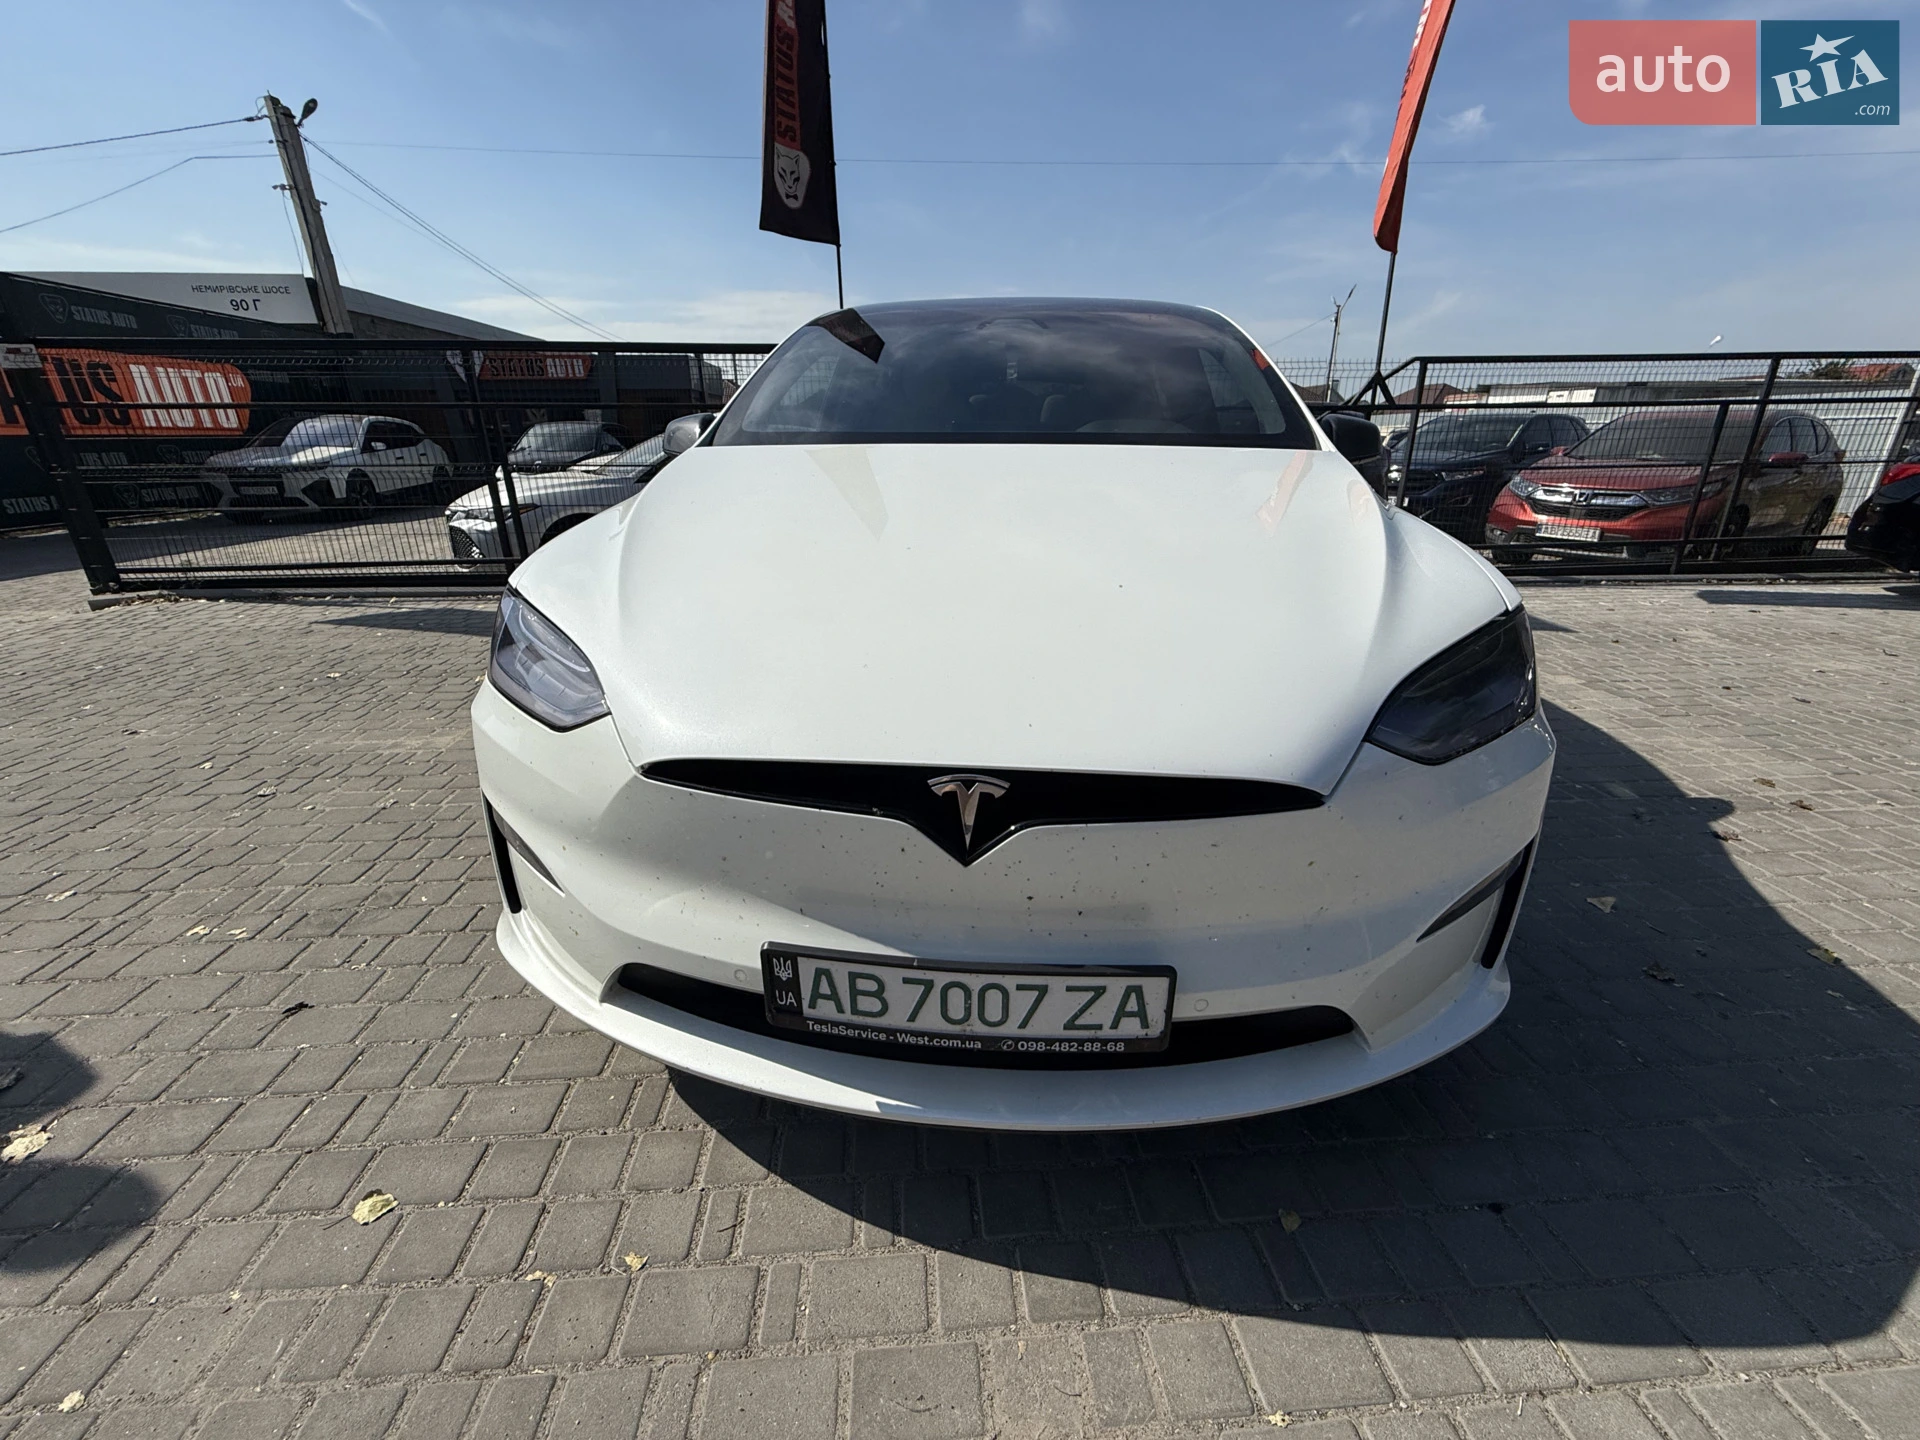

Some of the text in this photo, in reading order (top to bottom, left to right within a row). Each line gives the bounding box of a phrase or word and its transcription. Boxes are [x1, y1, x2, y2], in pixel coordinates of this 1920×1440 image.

[776, 25, 797, 142] STATUS
[191, 284, 291, 295] НЕМИРІВСЬКЕ ШОСЕ
[230, 298, 250, 312] 90
[70, 305, 137, 329] STATUS AUTO
[489, 357, 585, 378] STATUS AUTO
[3, 496, 49, 515] STATUS
[776, 989, 798, 1008] UA
[808, 967, 1151, 1031] AB 7007 ZA
[806, 1020, 887, 1042] TeslaService
[1017, 1041, 1125, 1052] 098-482-88-68
